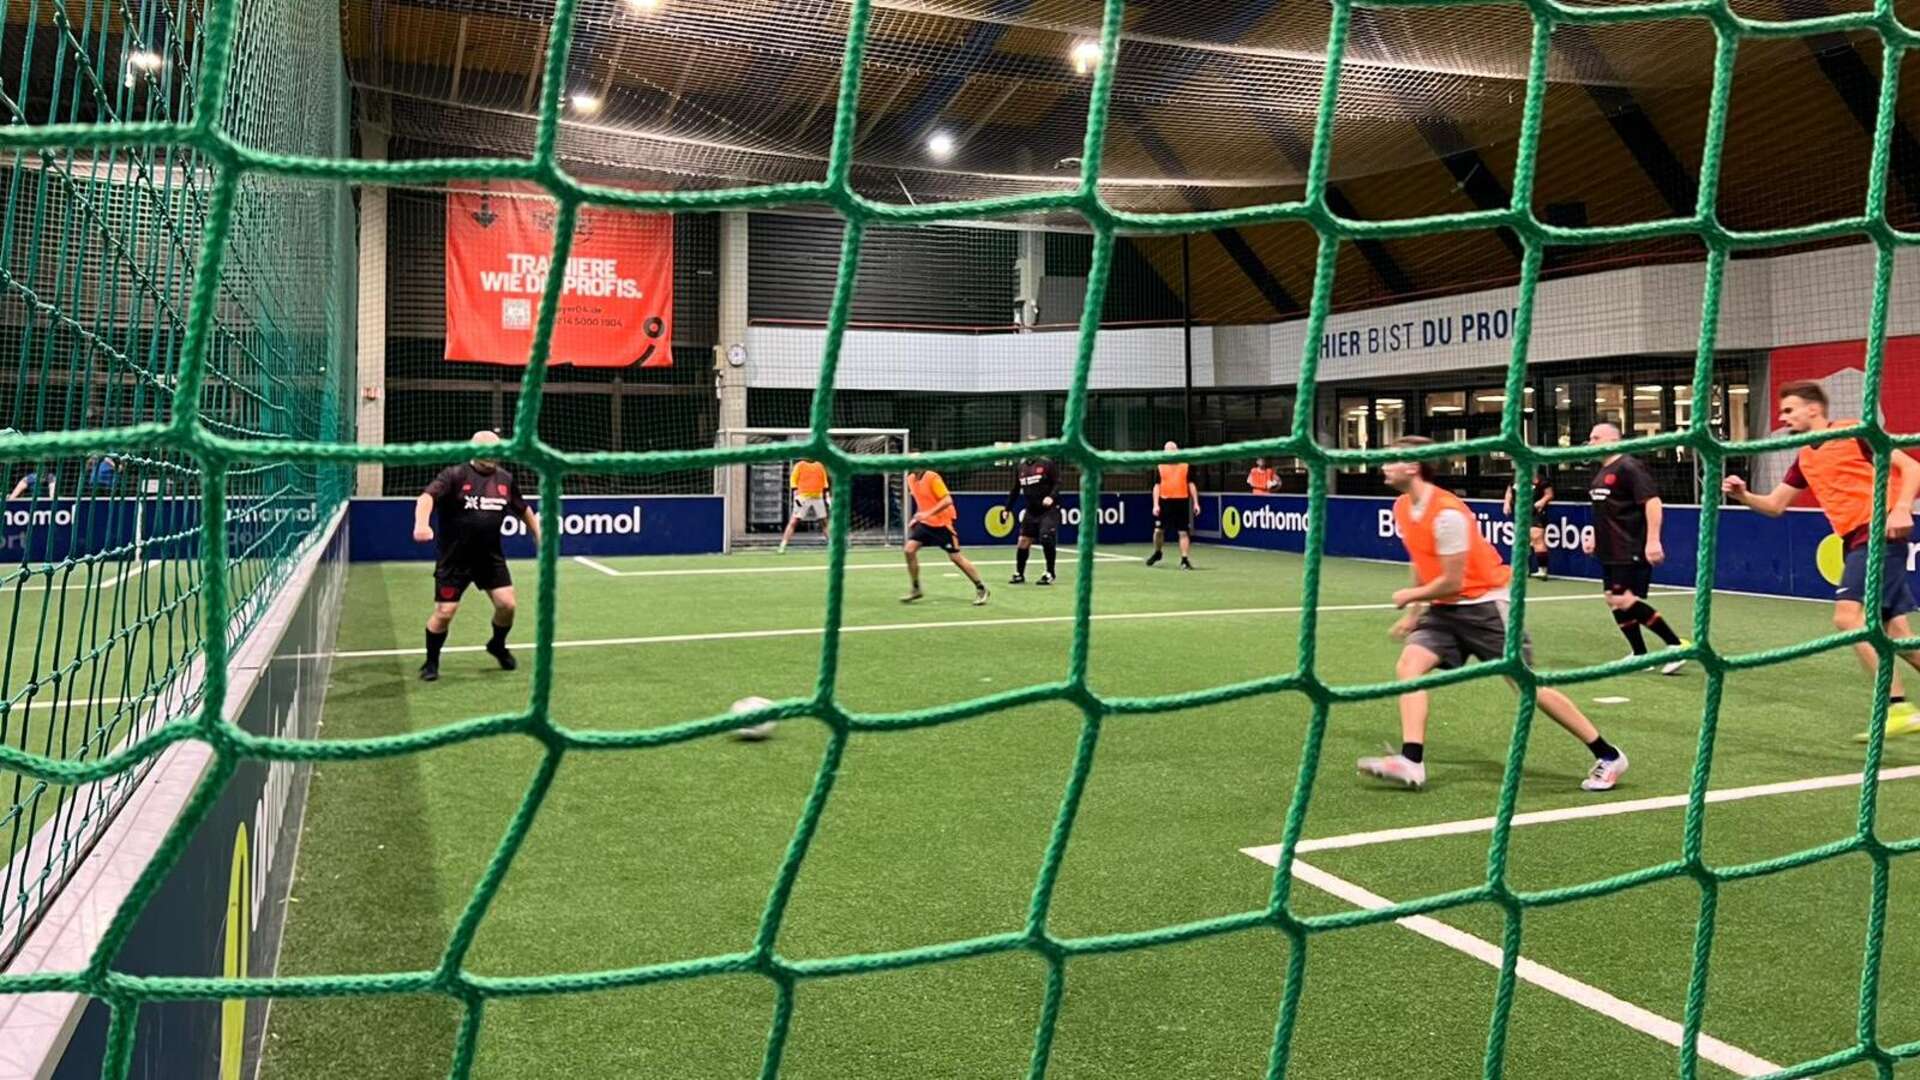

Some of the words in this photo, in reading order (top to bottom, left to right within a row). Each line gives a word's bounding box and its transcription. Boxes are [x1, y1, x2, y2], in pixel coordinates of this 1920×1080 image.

[480, 271, 524, 292] WIE
[525, 275, 549, 293] DI
[562, 276, 643, 299] PROFIS.
[1319, 331, 1361, 359] HIER
[1367, 323, 1414, 353] BIST
[1422, 317, 1452, 347] DU
[1242, 504, 1310, 532] orthomo
